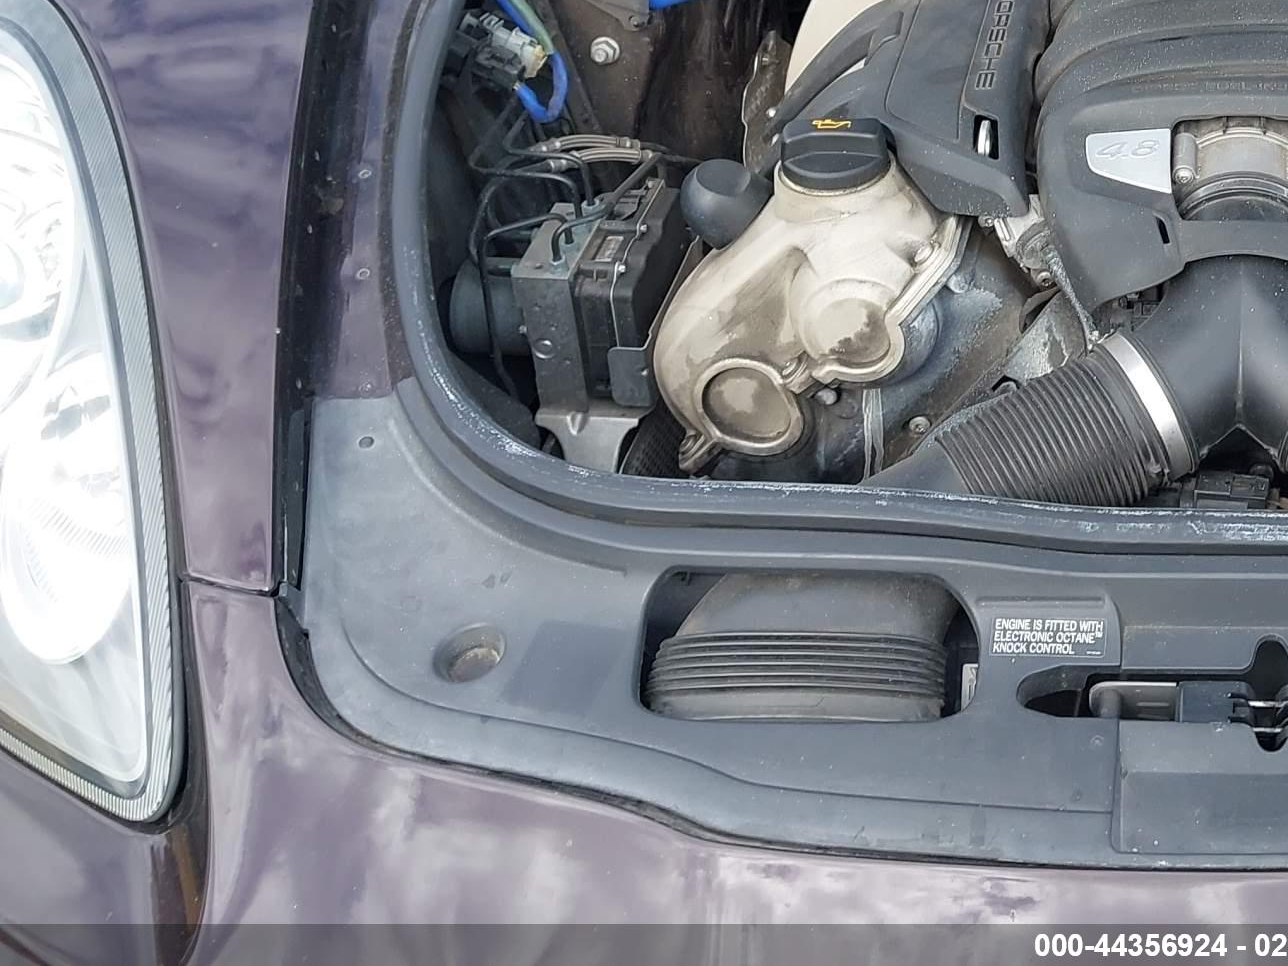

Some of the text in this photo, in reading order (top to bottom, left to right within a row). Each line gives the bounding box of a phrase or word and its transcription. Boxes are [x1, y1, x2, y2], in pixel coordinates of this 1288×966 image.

[995, 618, 1104, 632] ENGINE IS FITTED WITH
[994, 631, 1054, 643] ELECTRONIC
[992, 642, 1027, 653] KNOCK
[1029, 642, 1075, 654] CONTROL
